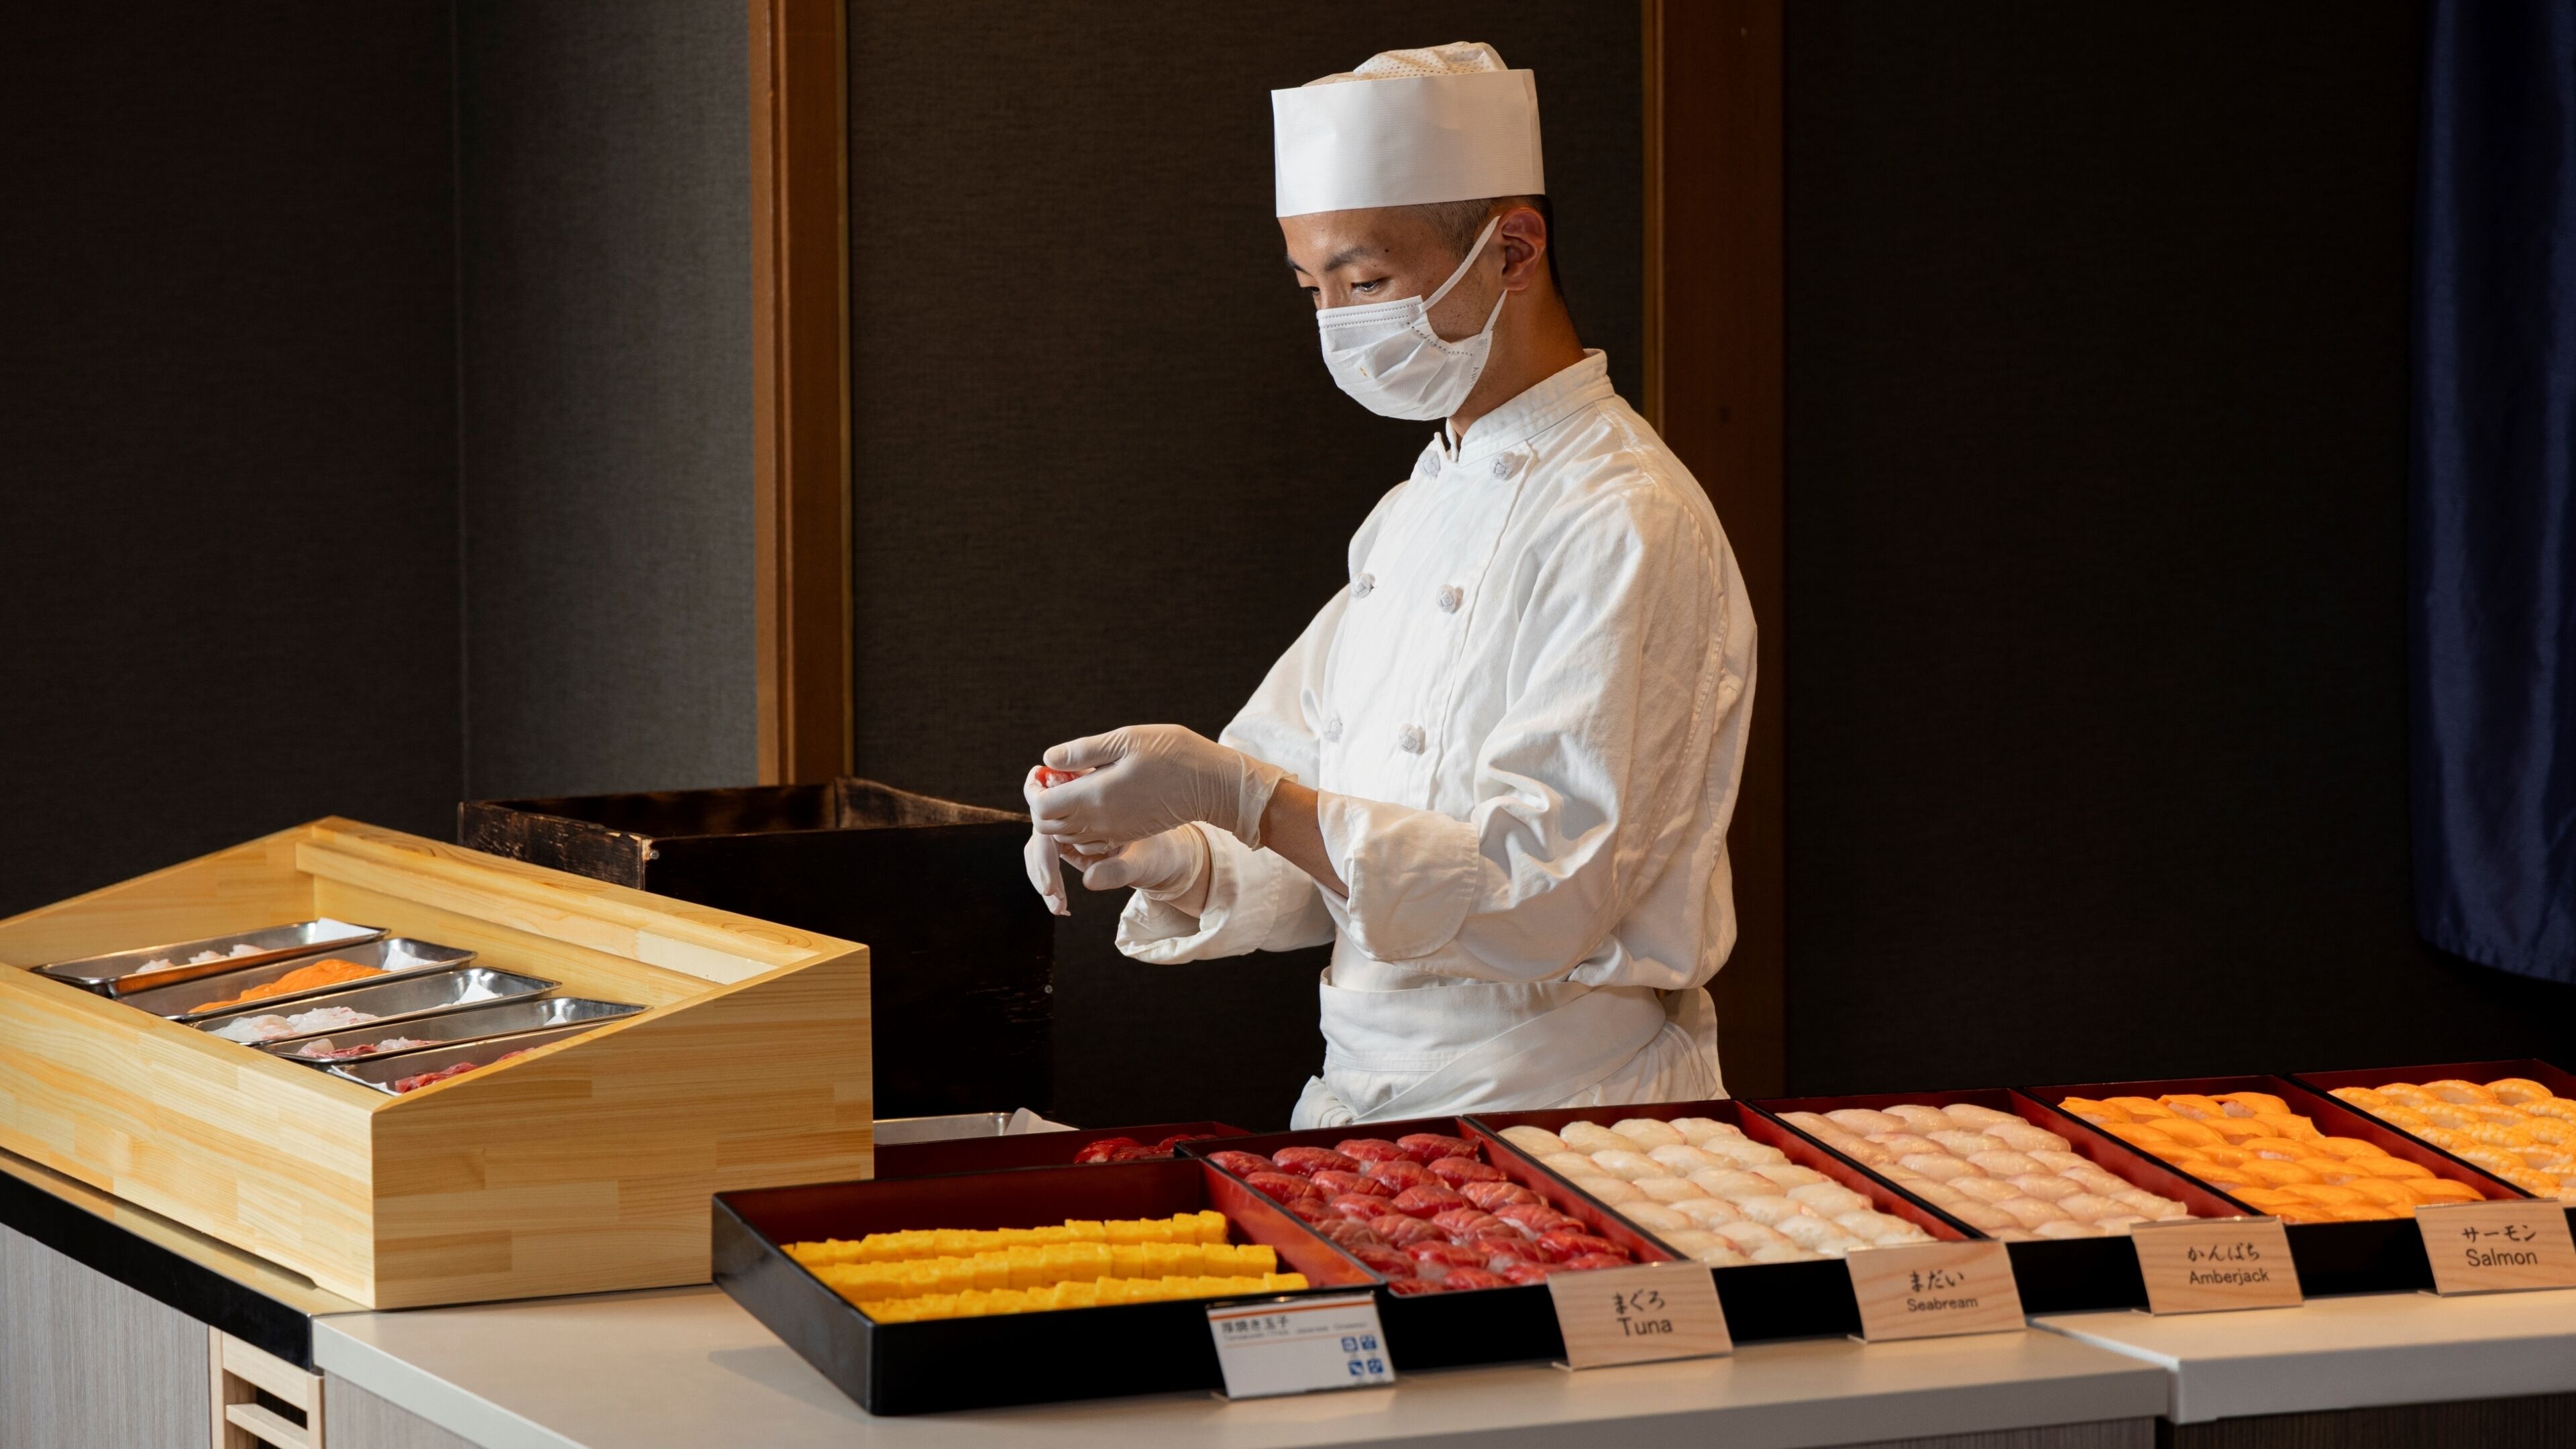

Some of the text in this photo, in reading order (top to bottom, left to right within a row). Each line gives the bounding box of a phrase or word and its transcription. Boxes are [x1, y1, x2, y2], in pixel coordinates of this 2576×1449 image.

[2461, 1224, 2536, 1242] サーモン
[2466, 1248, 2538, 1267] Salmon
[1910, 1269, 1965, 1292] まだい
[2189, 1267, 2269, 1285] Amberjack
[1613, 1288, 1666, 1314] まぐろ
[1907, 1297, 1978, 1312] Seabream
[1617, 1317, 1673, 1336] Tuna
